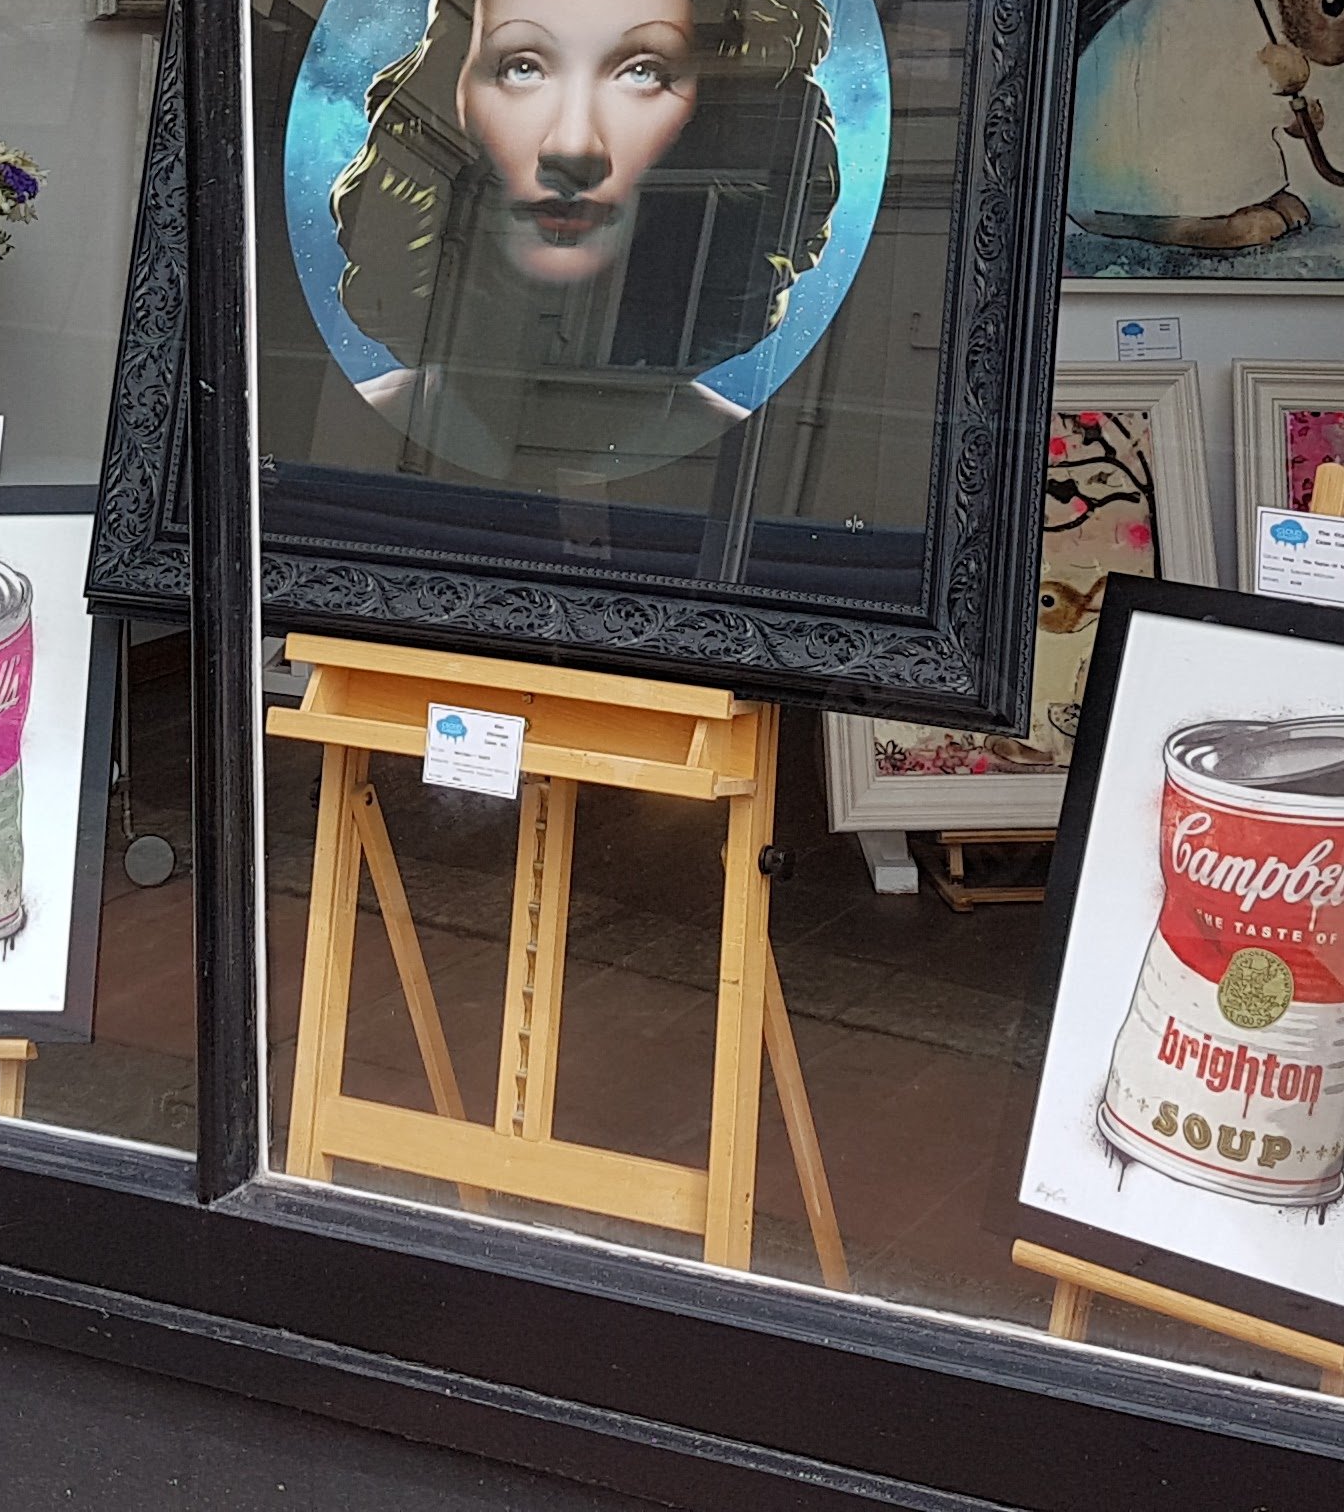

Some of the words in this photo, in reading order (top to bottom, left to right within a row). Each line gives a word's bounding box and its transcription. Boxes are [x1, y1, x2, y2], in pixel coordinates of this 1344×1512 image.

[1234, 921, 1303, 943] TASTE
[1315, 932, 1337, 946] OF
[1157, 1015, 1324, 1106] brighton
[1151, 1100, 1292, 1170] SOUP
